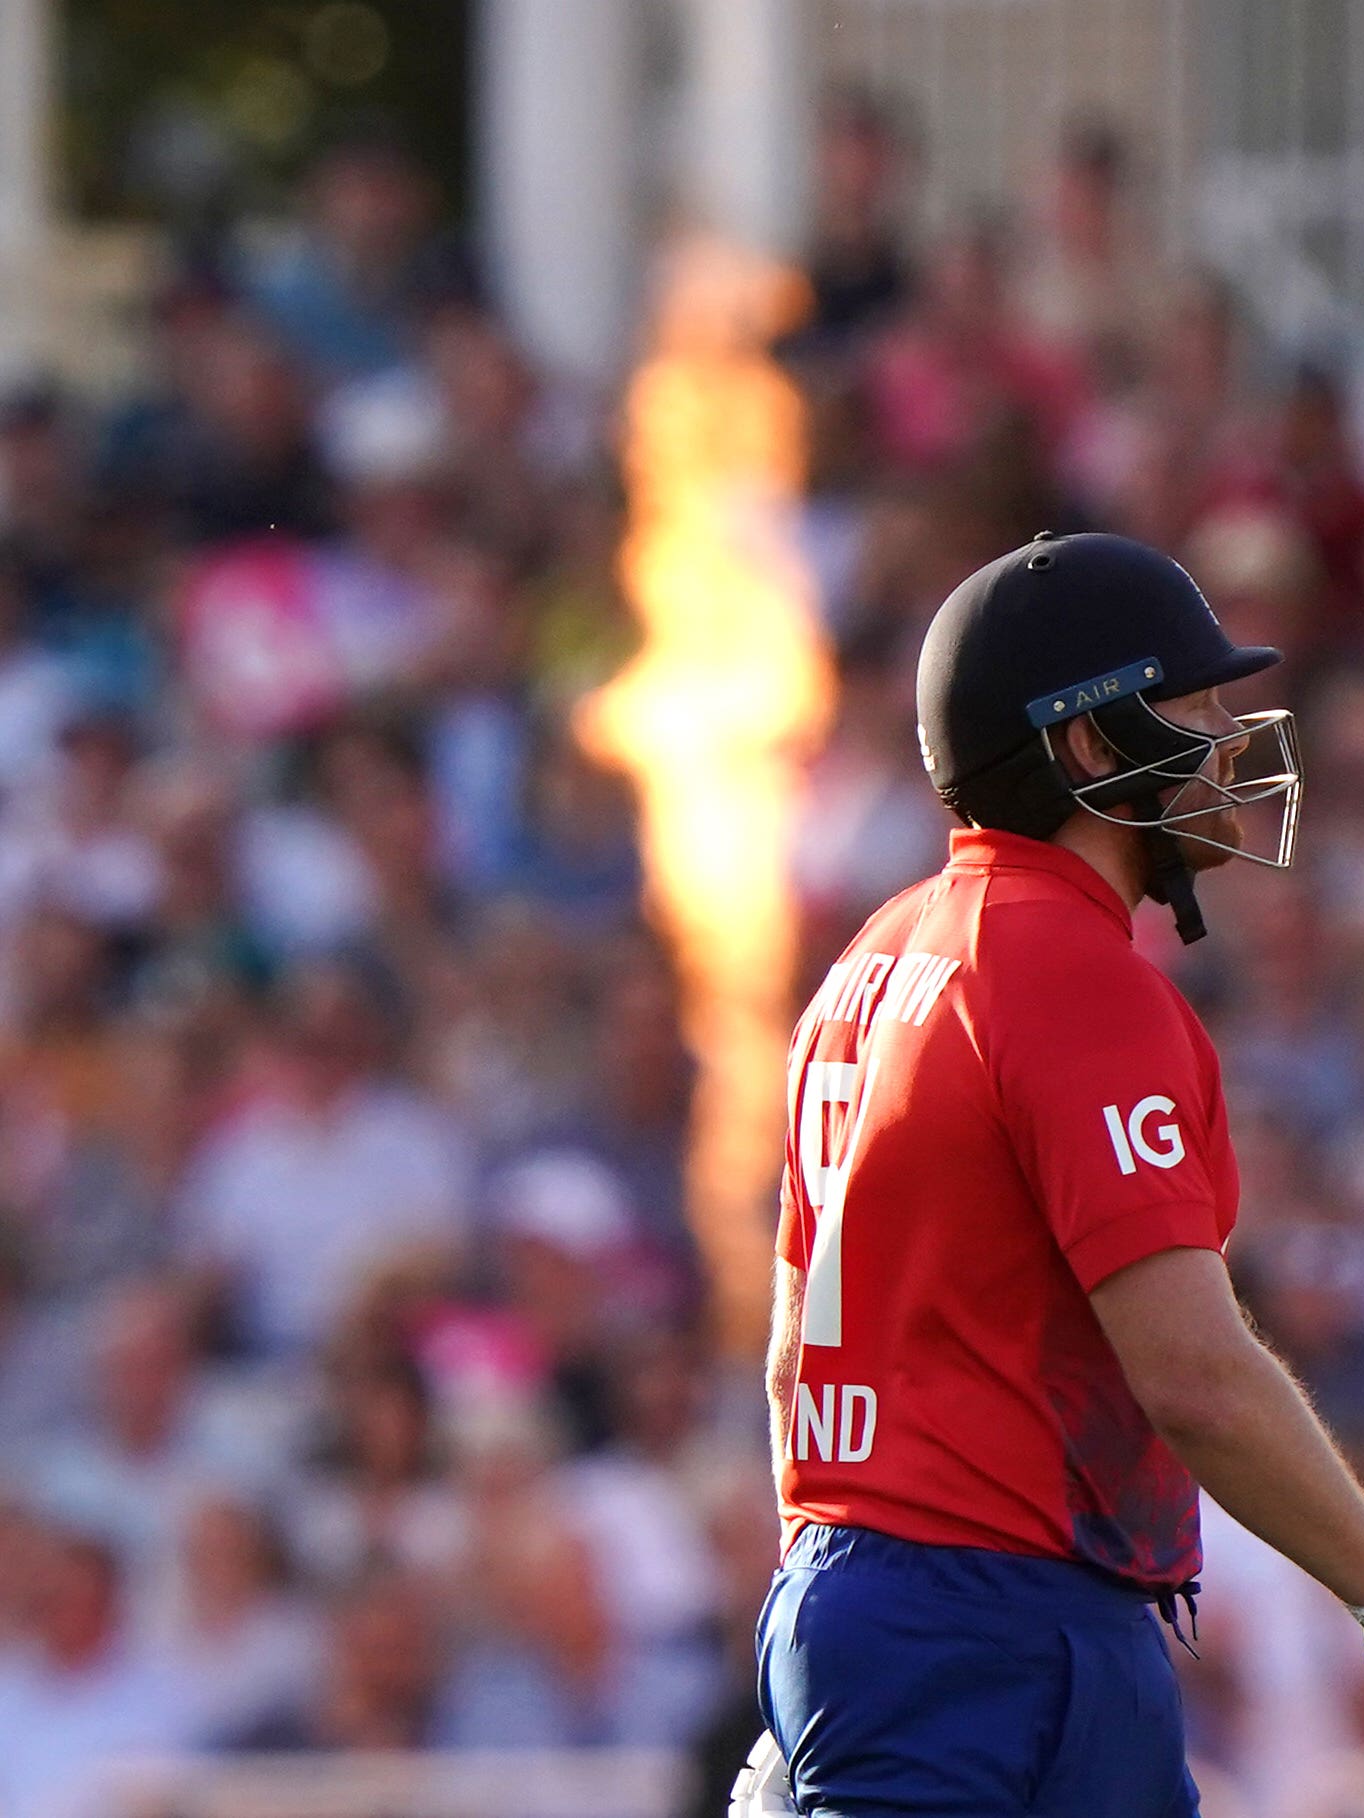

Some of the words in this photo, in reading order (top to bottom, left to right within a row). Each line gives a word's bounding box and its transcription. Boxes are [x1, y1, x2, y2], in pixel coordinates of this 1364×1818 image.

[1076, 677, 1120, 708] AIR
[1102, 1094, 1186, 1176] IG
[796, 1382, 878, 1463] ND
